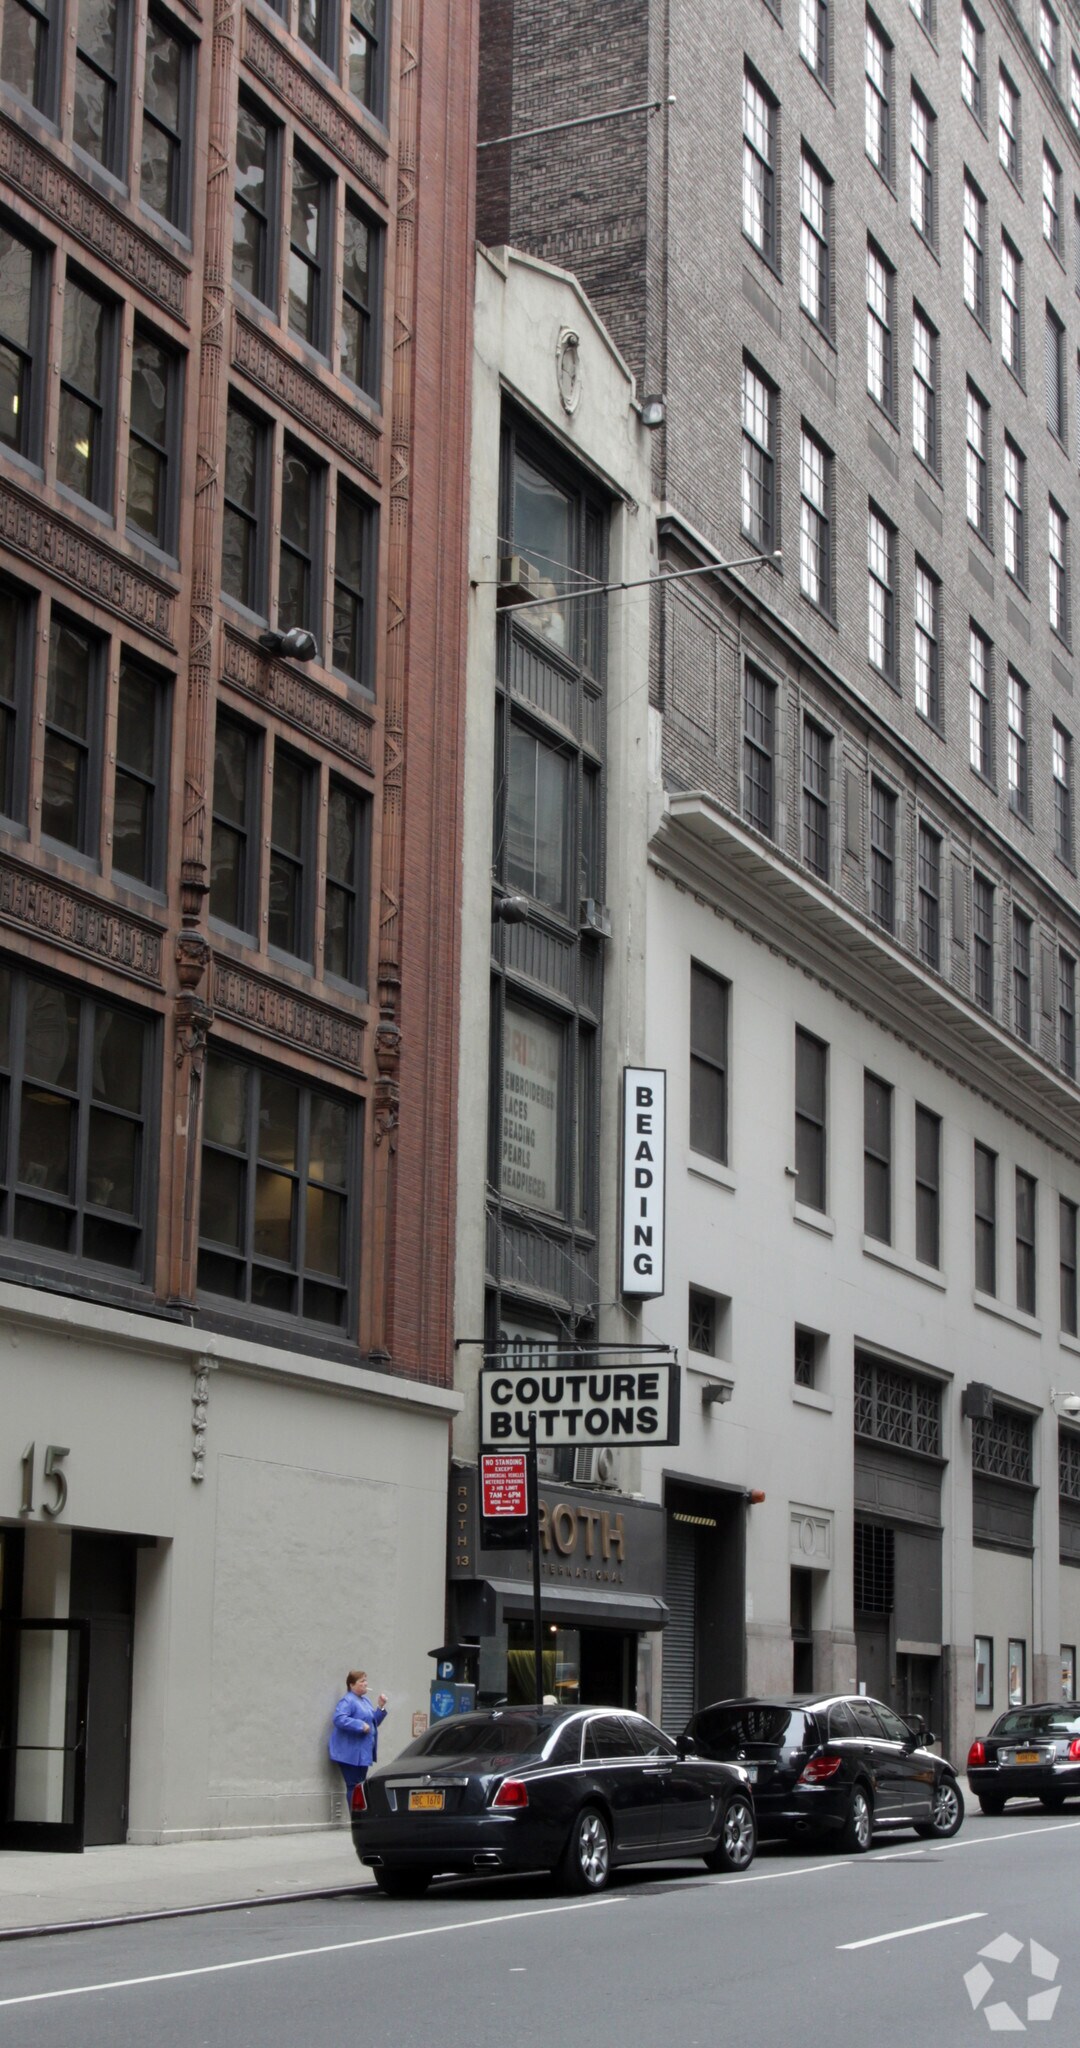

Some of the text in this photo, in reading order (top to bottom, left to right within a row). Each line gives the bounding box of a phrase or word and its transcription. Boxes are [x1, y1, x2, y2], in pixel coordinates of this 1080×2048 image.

[505, 1070, 554, 1110] EMBROIDERIES
[504, 1094, 528, 1121] LACES
[504, 1118, 535, 1148] BEADING
[503, 1141, 531, 1169] PEARLS
[503, 1165, 546, 1199] HEADPIECES
[634, 1086, 653, 1275] BEADING
[490, 1373, 659, 1405] COUTURE
[490, 1406, 658, 1438] BUTTONS
[495, 1458, 522, 1466] STANDING
[20, 1441, 70, 1516] 15
[489, 1491, 503, 1499] 7AM
[455, 1486, 470, 1566] ROTH 13
[538, 1499, 625, 1562] ROTH
[527, 1561, 624, 1584] ITERNATIONAL
[442, 1661, 453, 1678] P
